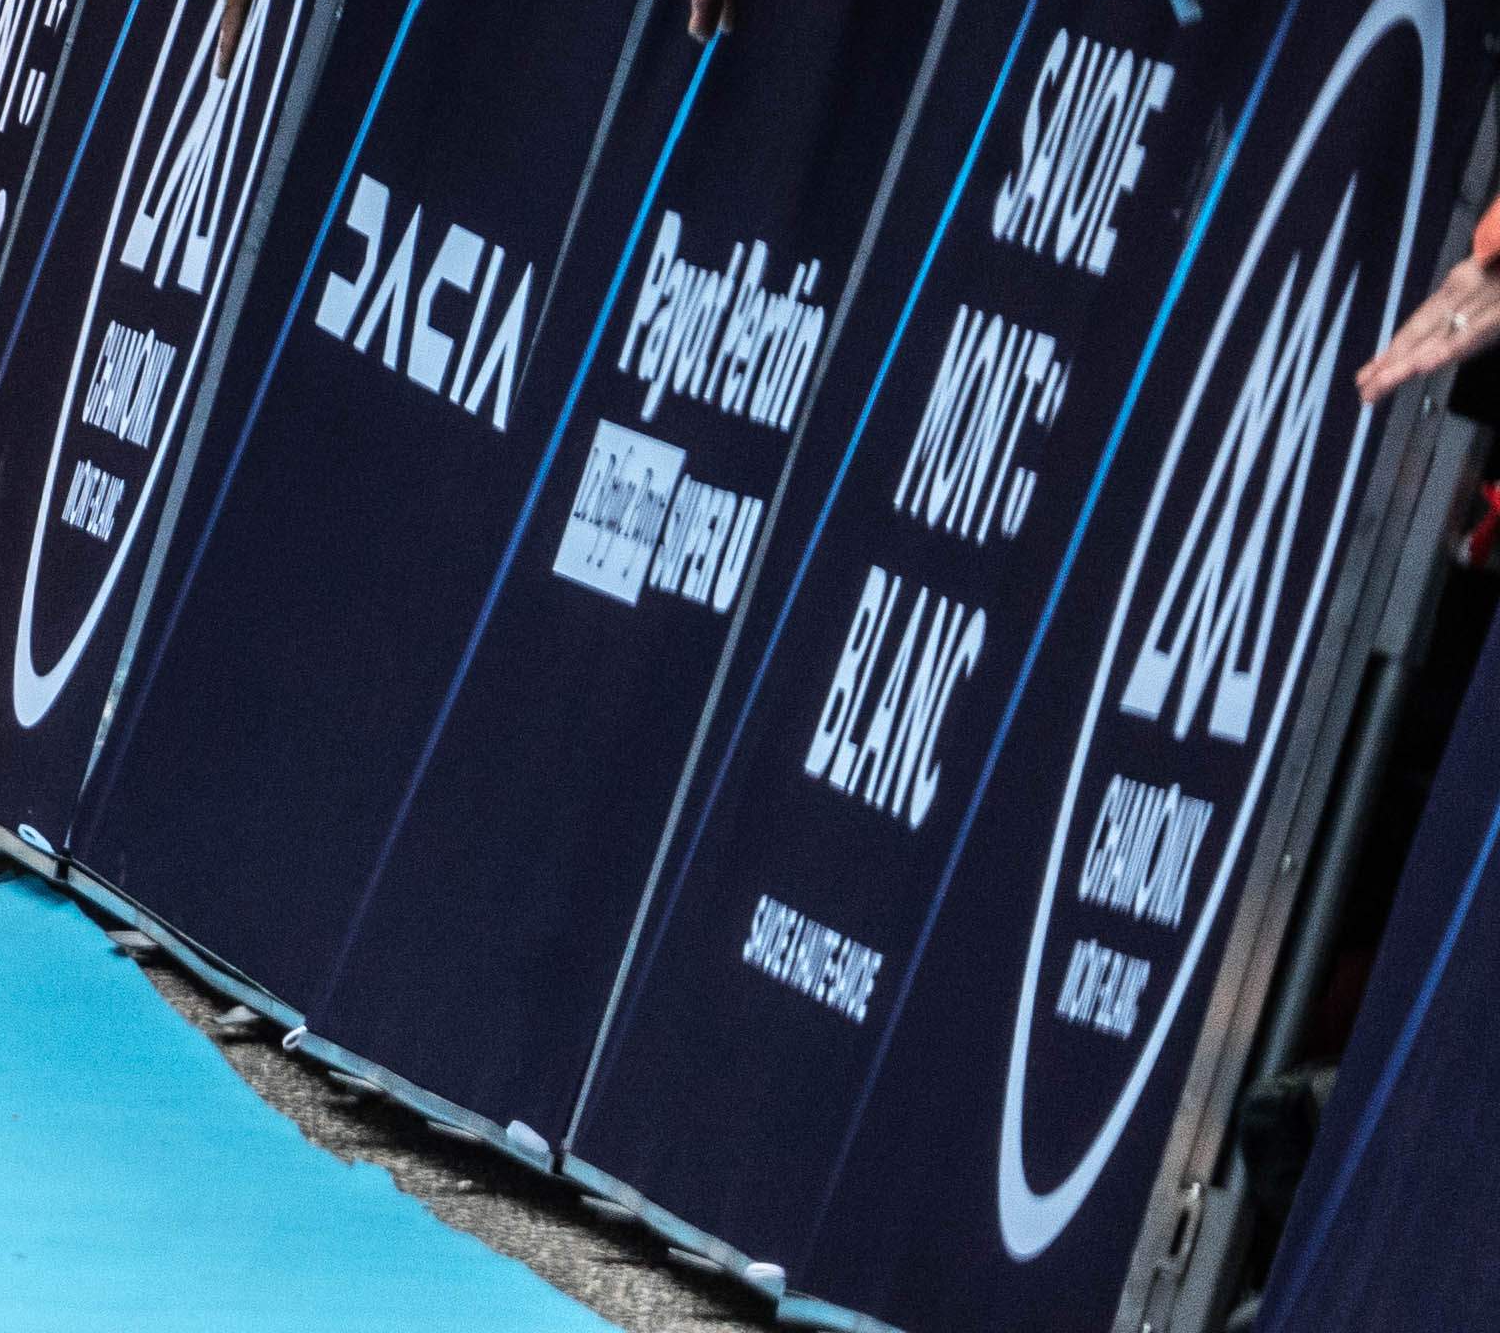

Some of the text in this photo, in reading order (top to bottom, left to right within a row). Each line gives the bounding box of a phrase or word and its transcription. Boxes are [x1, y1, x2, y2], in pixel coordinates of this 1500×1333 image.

[991, 26, 1176, 277] SAVOIE
[81, 319, 178, 450] CHAMONIX
[314, 172, 534, 433] DACIA
[617, 209, 825, 433] Payot Pertin
[893, 304, 1058, 545] MONT
[648, 473, 764, 614] SUPER U
[802, 564, 987, 830] BLANC
[1077, 770, 1214, 930] CHAMONIX
